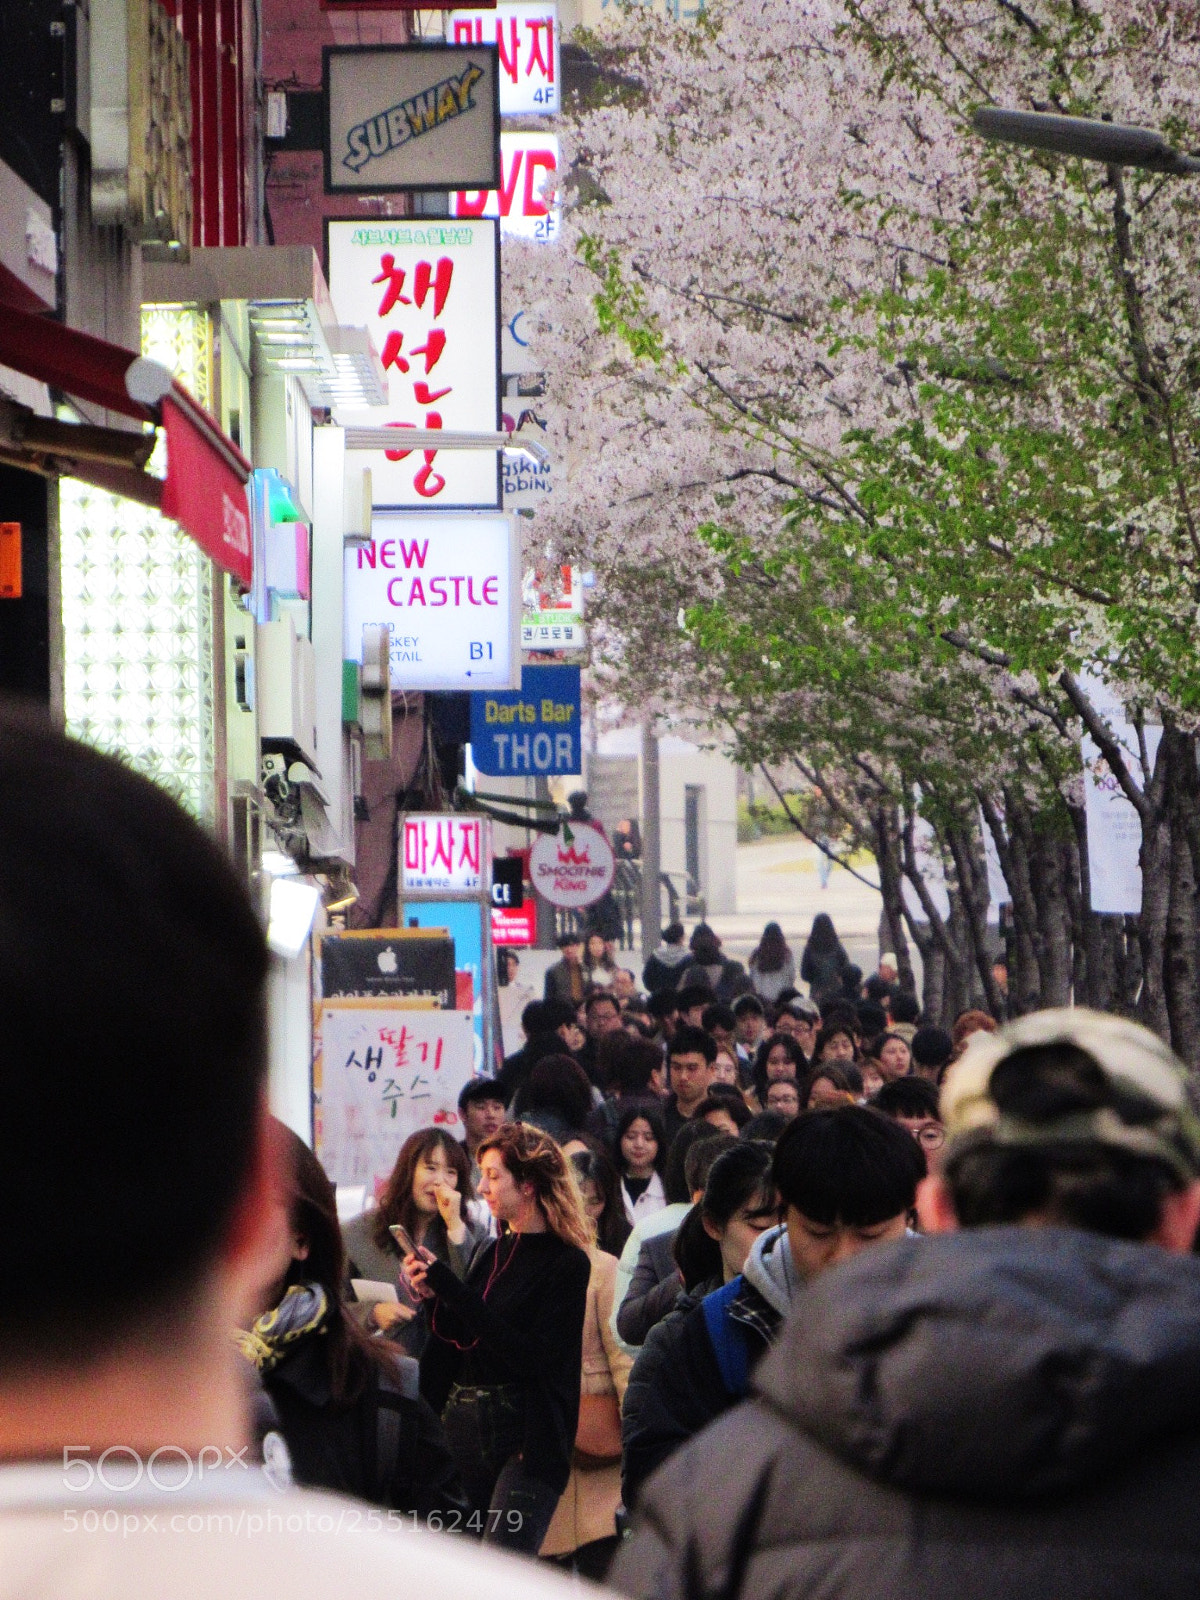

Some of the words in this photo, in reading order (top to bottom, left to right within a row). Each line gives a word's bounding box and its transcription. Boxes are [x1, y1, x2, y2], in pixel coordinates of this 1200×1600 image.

[533, 87, 554, 103] 4F
[342, 61, 484, 174] SUBWAY
[535, 221, 554, 238] 2F
[357, 538, 429, 569] NEW
[387, 575, 498, 607] CASTLE
[469, 641, 493, 660] B1
[485, 700, 536, 723] Darts
[541, 700, 574, 722] Bar
[493, 732, 573, 769] THOR
[404, 820, 480, 875] 마사지
[382, 1075, 431, 1119] 주스
